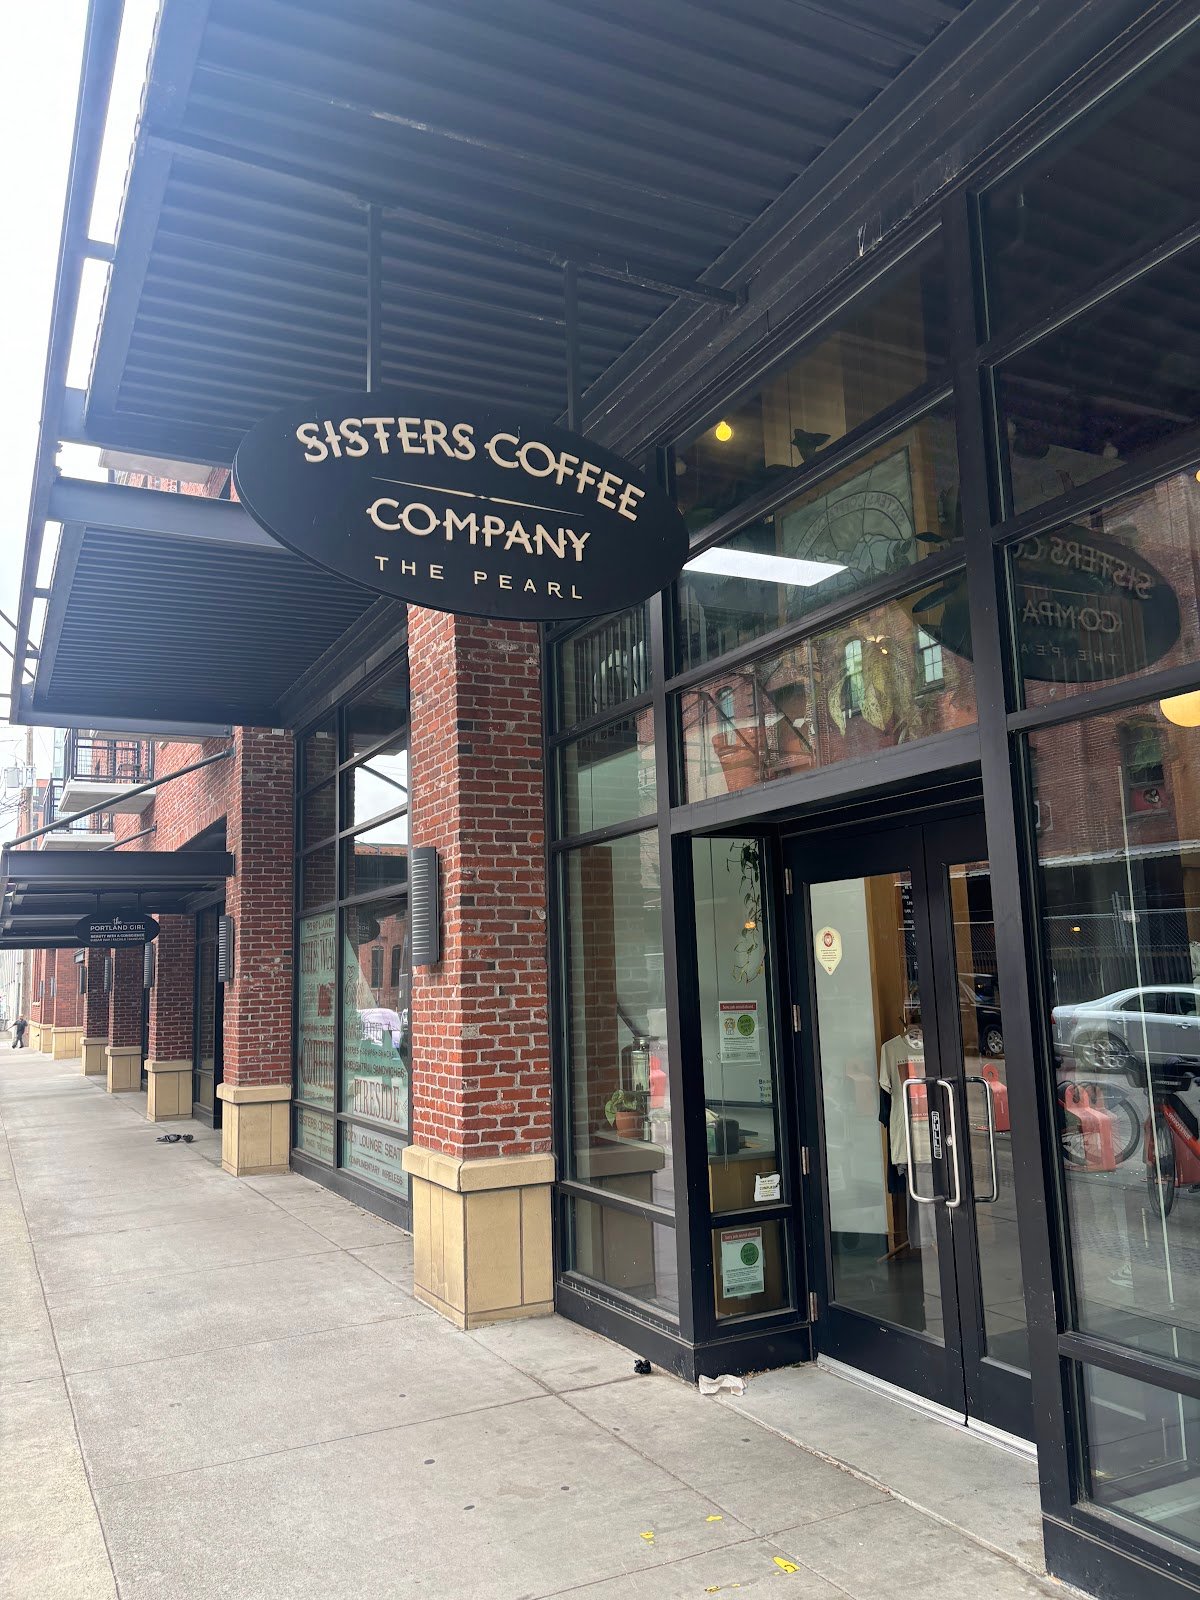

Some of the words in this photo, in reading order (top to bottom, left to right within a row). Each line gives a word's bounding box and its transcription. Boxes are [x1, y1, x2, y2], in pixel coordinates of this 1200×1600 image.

[296, 417, 476, 462] SISTERS
[484, 433, 646, 522] COFFEE
[366, 498, 591, 562] COMPANY
[375, 555, 444, 580] THE
[474, 571, 582, 600] PEARL
[354, 1078, 400, 1123] FIRESIDE
[360, 1134, 382, 1154] LOUNGE
[384, 1143, 402, 1160] SEAT
[933, 1115, 941, 1149] PULL
